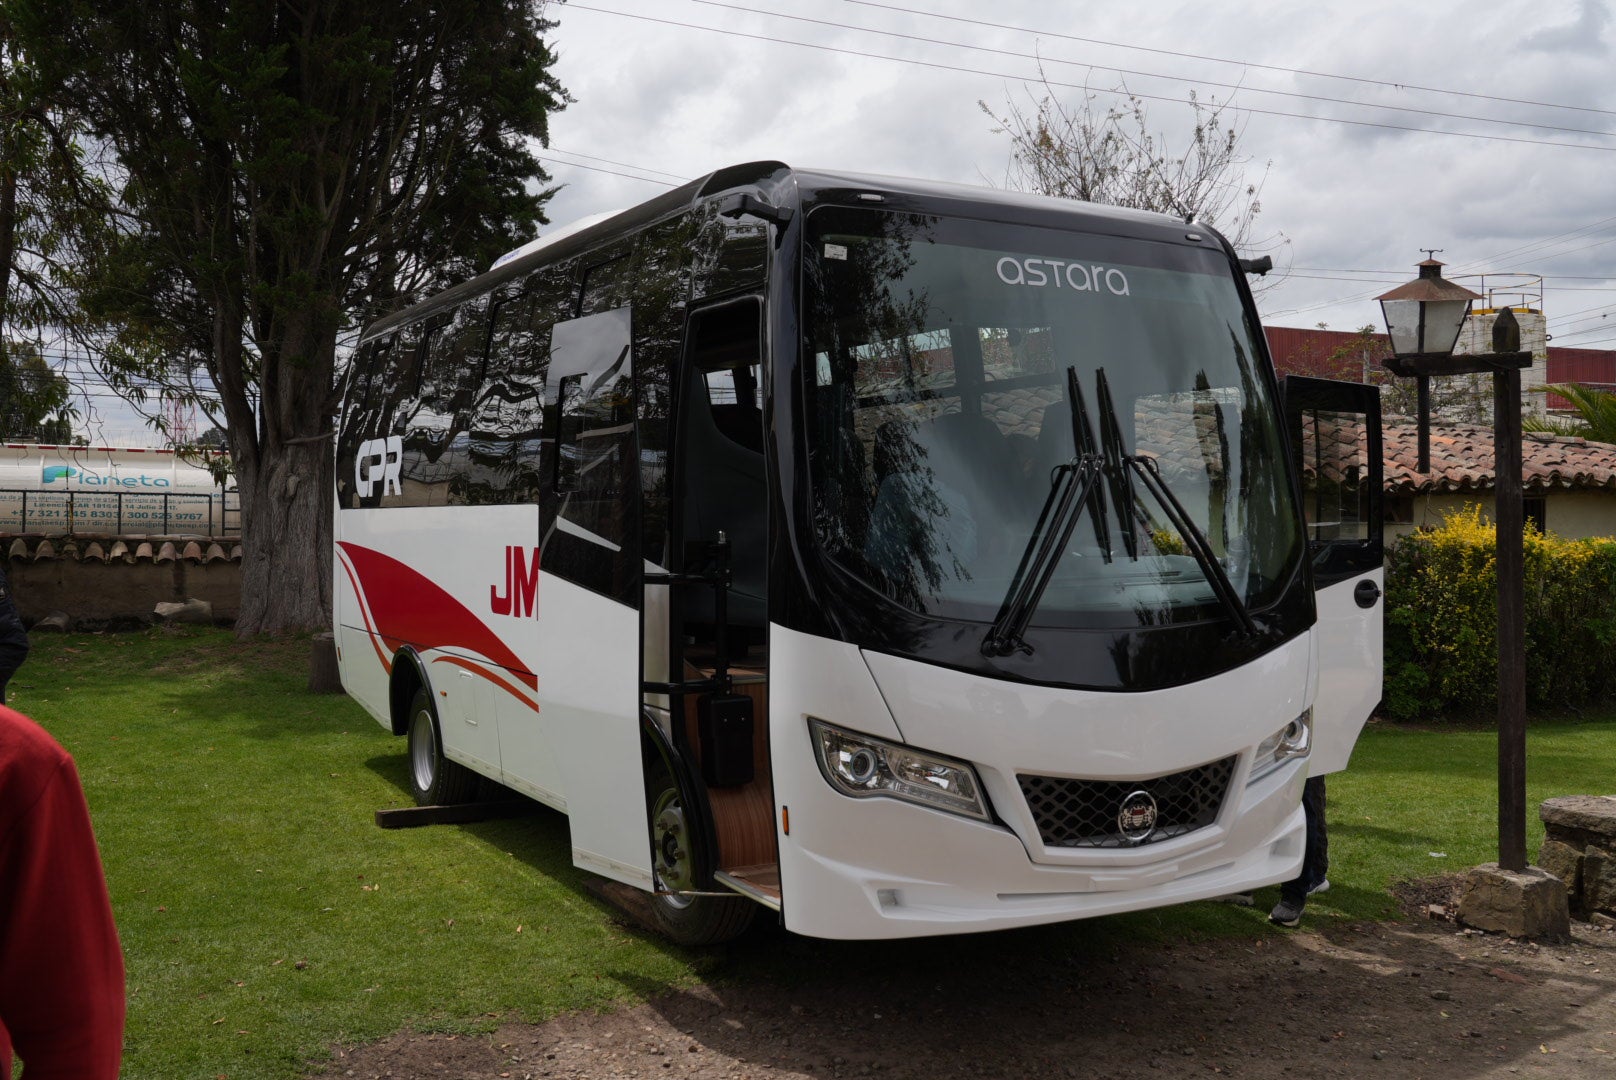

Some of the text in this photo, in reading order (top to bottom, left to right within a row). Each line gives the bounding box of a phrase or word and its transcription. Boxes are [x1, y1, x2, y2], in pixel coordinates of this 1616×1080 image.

[42, 465, 170, 488] Planeta
[37, 509, 60, 518] 321
[90, 510, 121, 519] 8303
[127, 511, 149, 519] 300
[490, 545, 540, 618] JM
